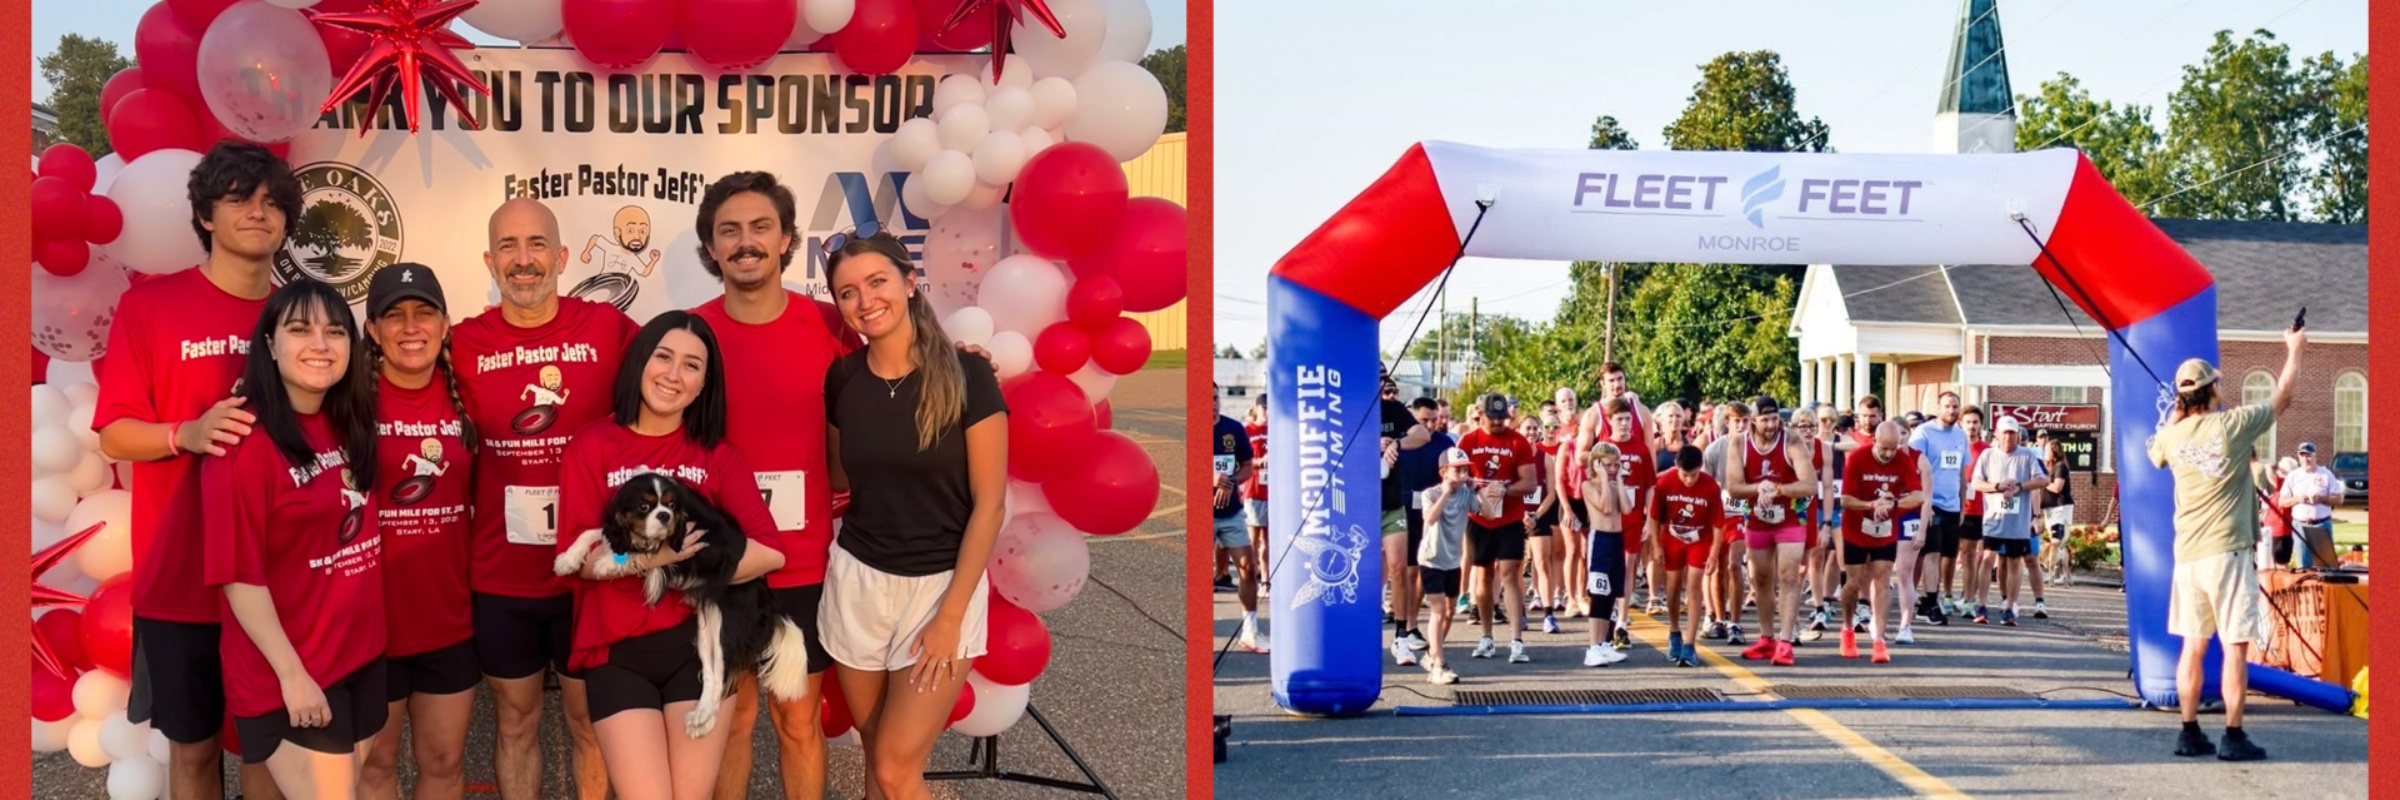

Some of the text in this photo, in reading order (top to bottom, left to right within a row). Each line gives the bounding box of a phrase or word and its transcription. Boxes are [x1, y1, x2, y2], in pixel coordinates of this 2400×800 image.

[534, 71, 595, 133] TO
[608, 73, 705, 134] OUR
[717, 73, 957, 135] SPONSOR
[505, 168, 573, 201] Faster
[578, 164, 649, 197] Pastor
[326, 169, 394, 227] OAKS
[1573, 172, 1922, 215] FLEET FEET
[379, 238, 397, 252] 2022
[1699, 236, 1800, 252] MONROE
[280, 258, 294, 274] ON
[181, 334, 252, 361] Faster Pas
[477, 342, 598, 375] Faster Pastor Jeff's
[2013, 405, 2069, 425] Start
[394, 420, 439, 437] Pastor
[1328, 368, 1345, 487] TIMING
[2065, 422, 2097, 430] CHURCH
[522, 438, 545, 448] MILE
[547, 436, 566, 446] FOR
[2061, 442, 2093, 453] TH US
[496, 449, 545, 457] SEPTEMBER
[525, 488, 546, 496] FLEET
[379, 509, 398, 518] FUN
[398, 508, 420, 517] MILE
[422, 507, 440, 516] FOR
[542, 502, 556, 530] 1
